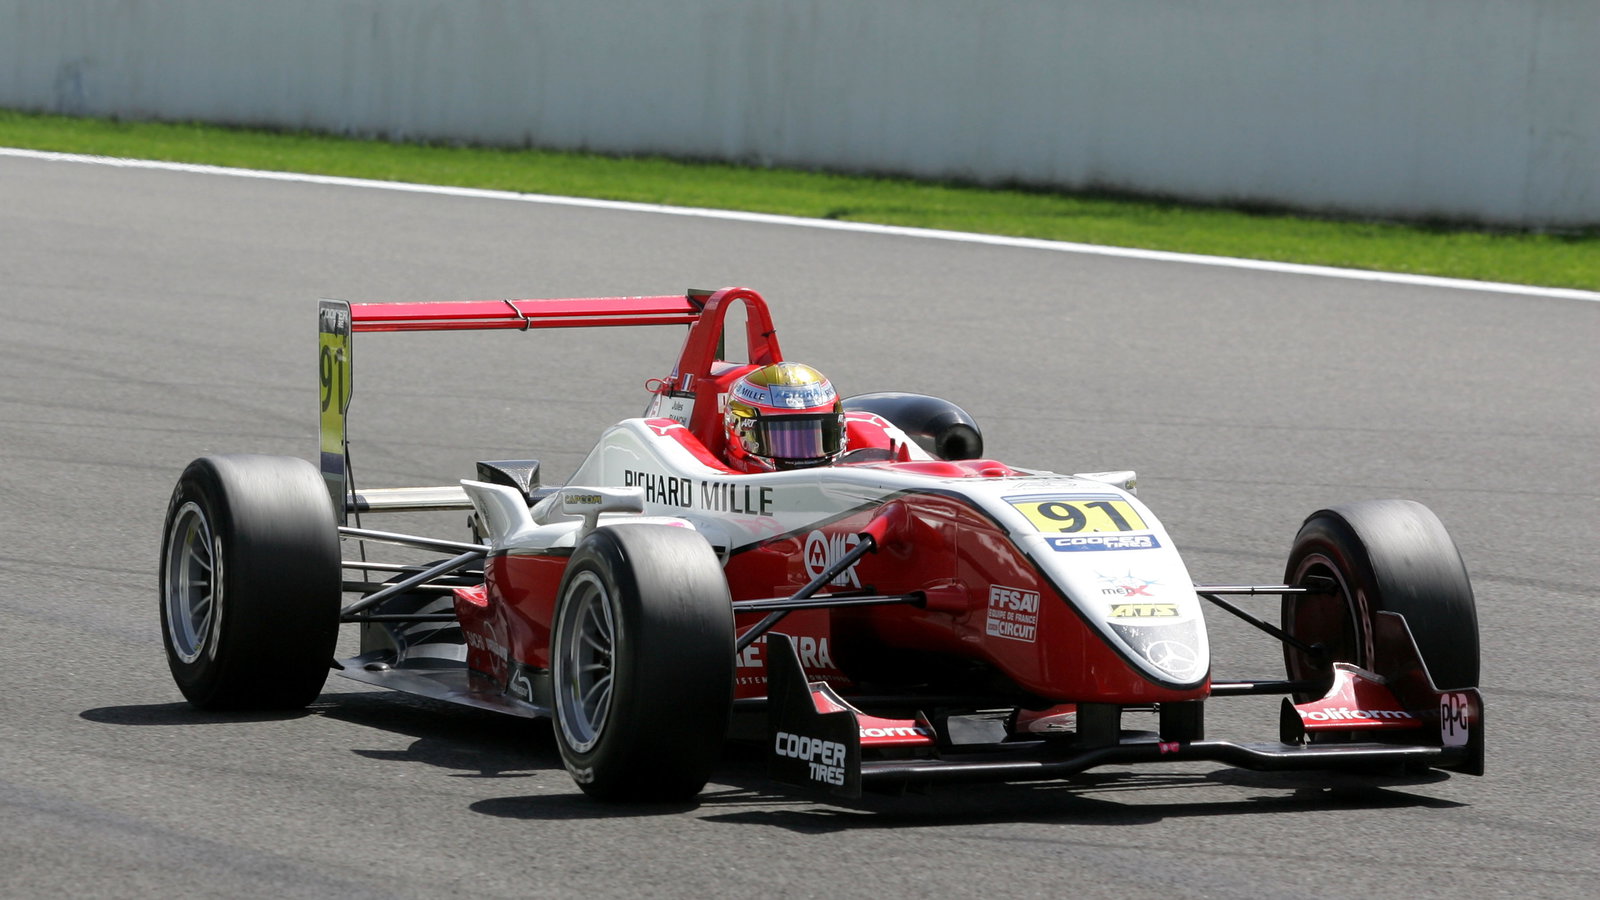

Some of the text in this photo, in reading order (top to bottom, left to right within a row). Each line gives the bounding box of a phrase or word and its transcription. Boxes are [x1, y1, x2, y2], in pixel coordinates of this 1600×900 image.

[320, 344, 345, 415] 91
[741, 387, 765, 400] MILLE
[741, 418, 758, 428] ART
[564, 494, 603, 505] CAPCOM
[701, 480, 774, 516] MILLE
[1037, 501, 1133, 533] 91
[1107, 603, 1181, 618] ATS
[1000, 621, 1035, 640] CIRCUIT
[775, 731, 847, 768] COOPER
[808, 762, 845, 786] TIRES
